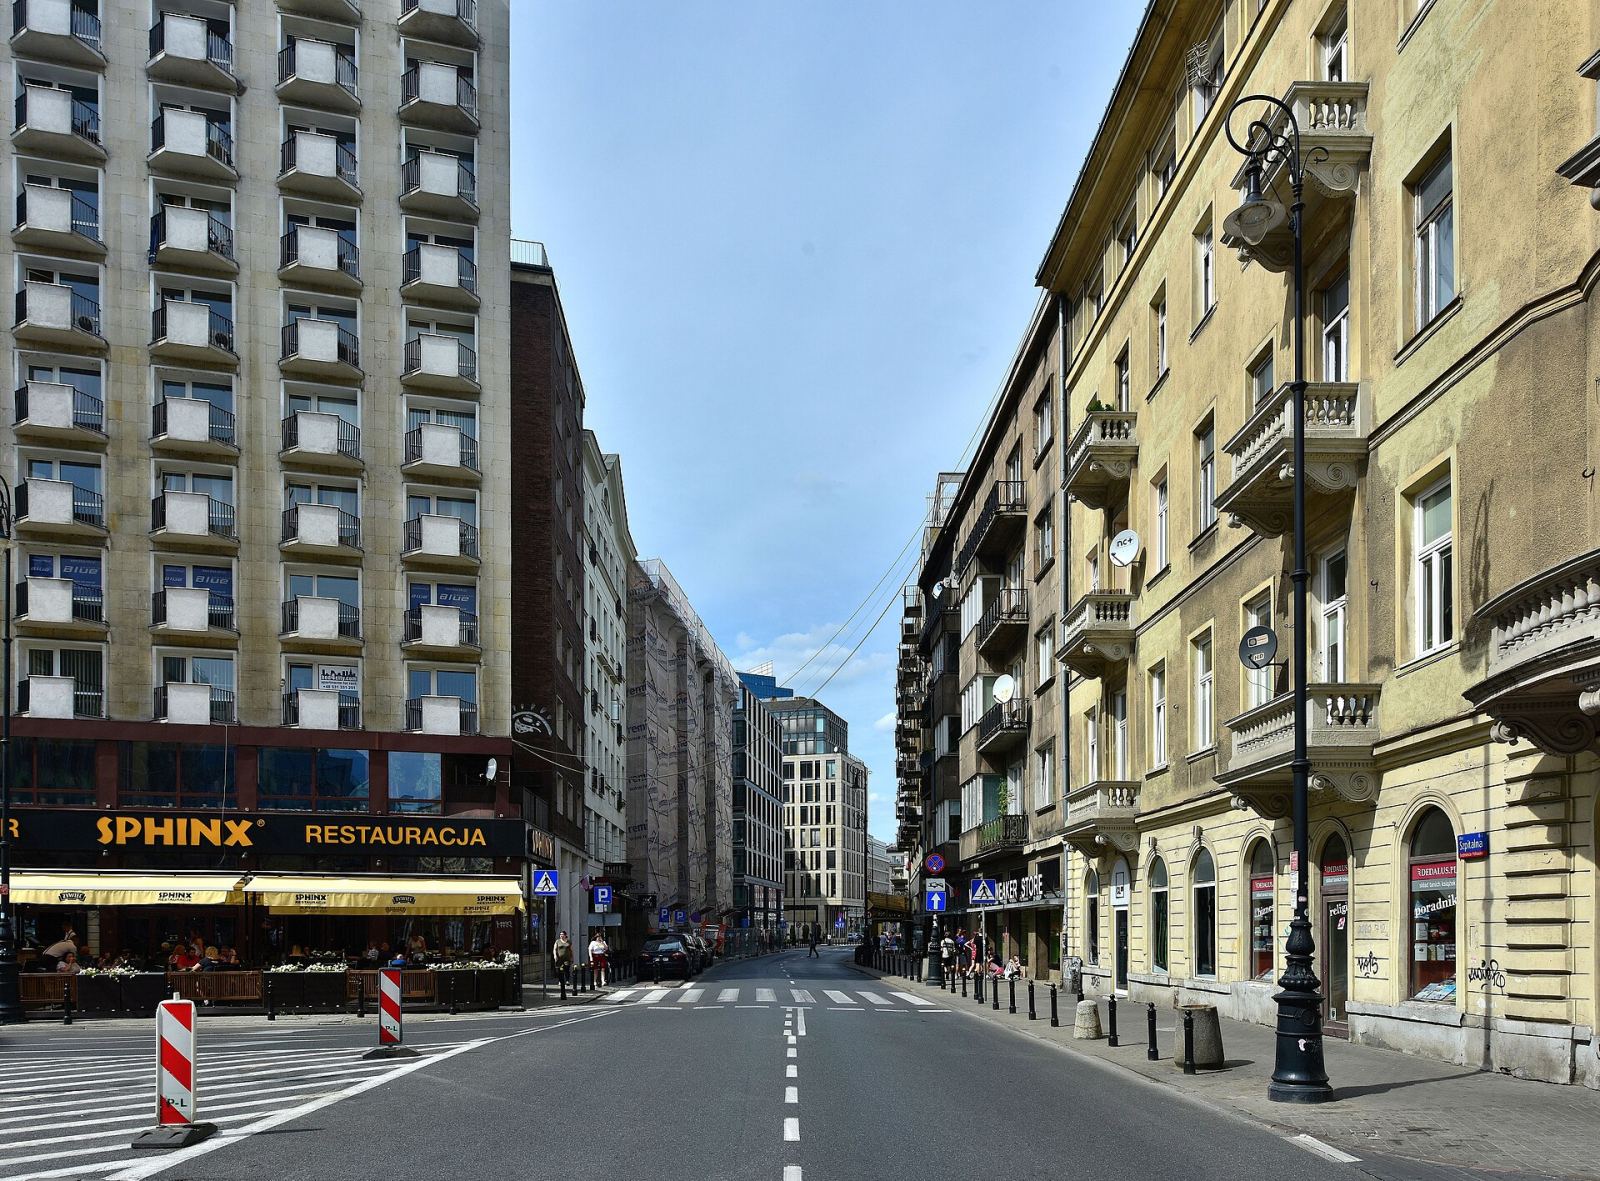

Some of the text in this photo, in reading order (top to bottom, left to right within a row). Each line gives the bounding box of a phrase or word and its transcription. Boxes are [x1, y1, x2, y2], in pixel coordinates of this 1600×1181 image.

[1117, 537, 1133, 547] nc+
[96, 816, 487, 847] SPHINX RESTAURACJA
[1459, 839, 1484, 852] Szpitalna
[1021, 874, 1043, 898] STORE
[167, 1098, 188, 1107] P-L
